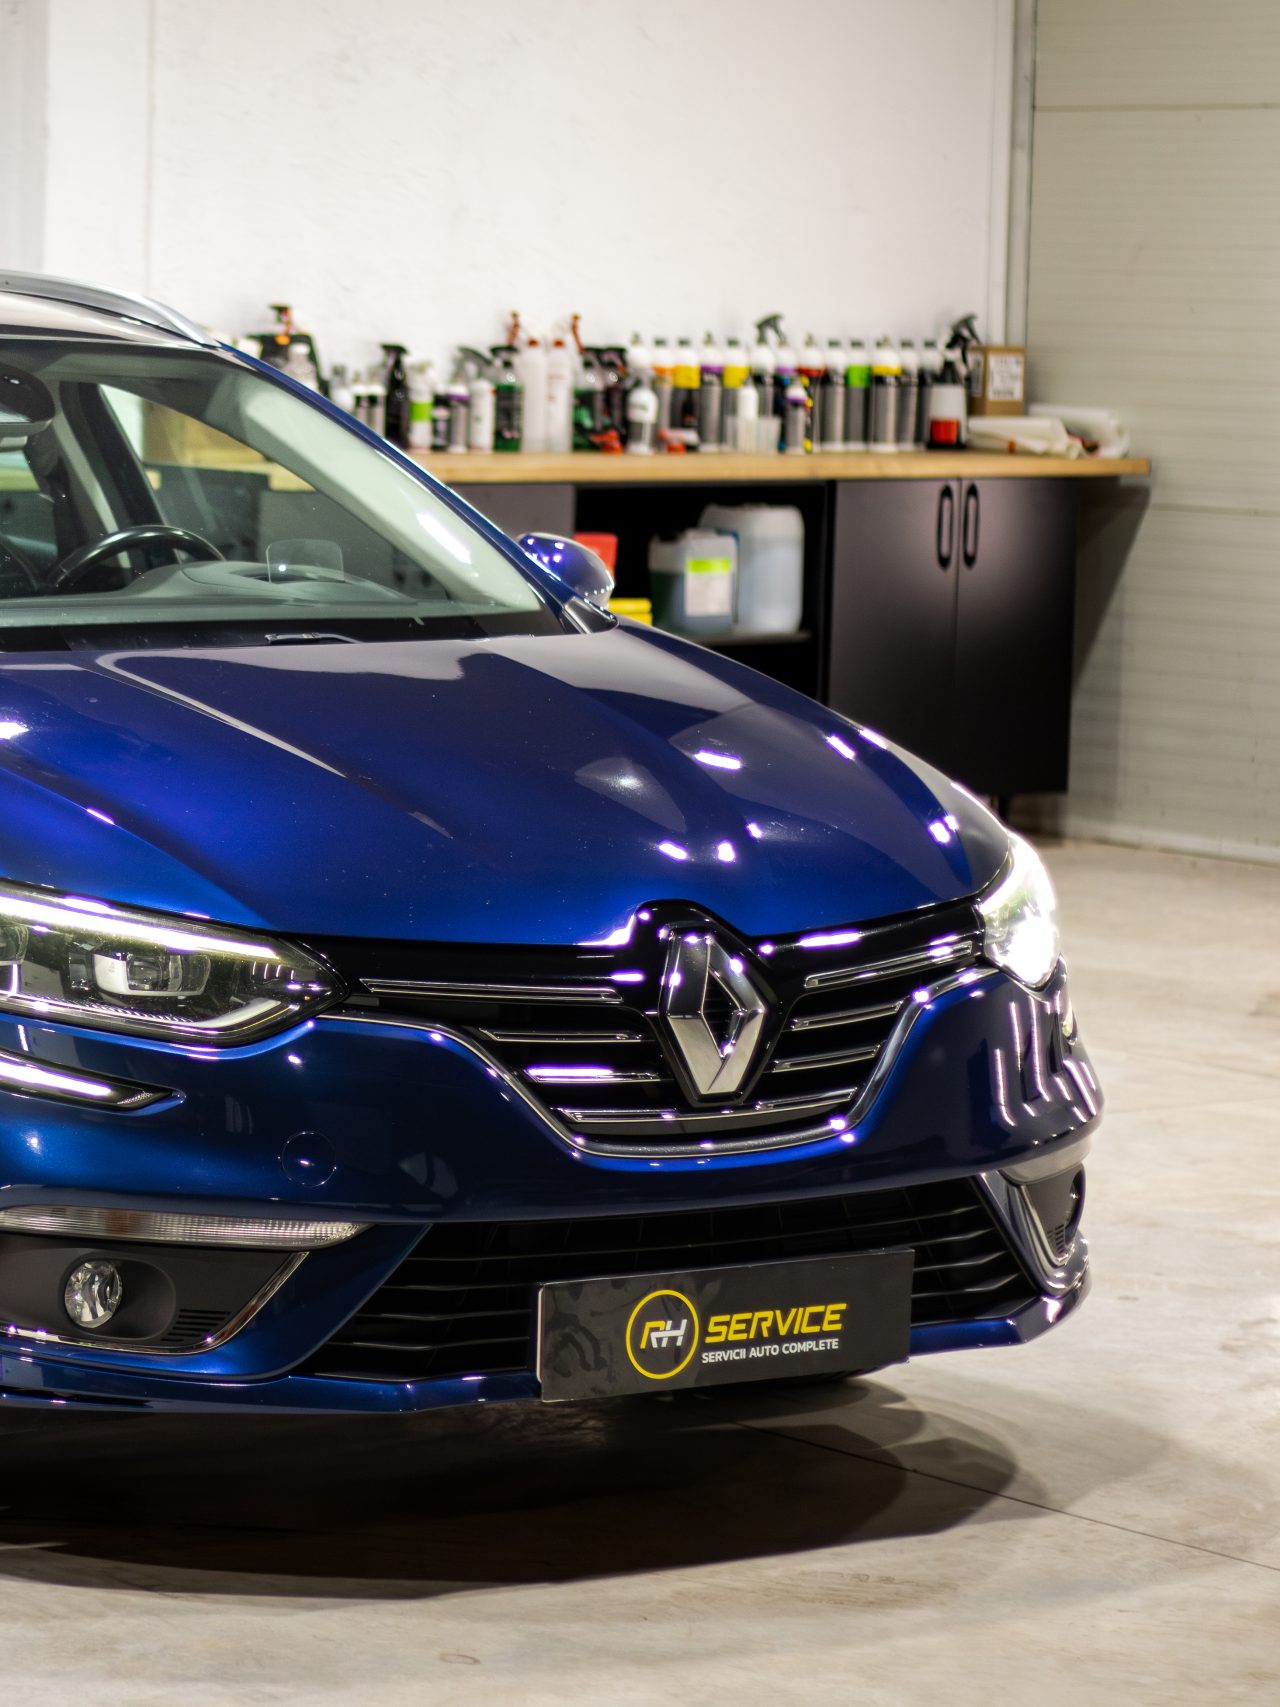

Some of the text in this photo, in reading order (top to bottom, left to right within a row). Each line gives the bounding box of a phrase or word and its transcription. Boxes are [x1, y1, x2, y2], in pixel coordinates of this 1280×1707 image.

[640, 1303, 847, 1350] RH SERVICE
[701, 1338, 840, 1364] SERVICII AUTO COMPLETE
